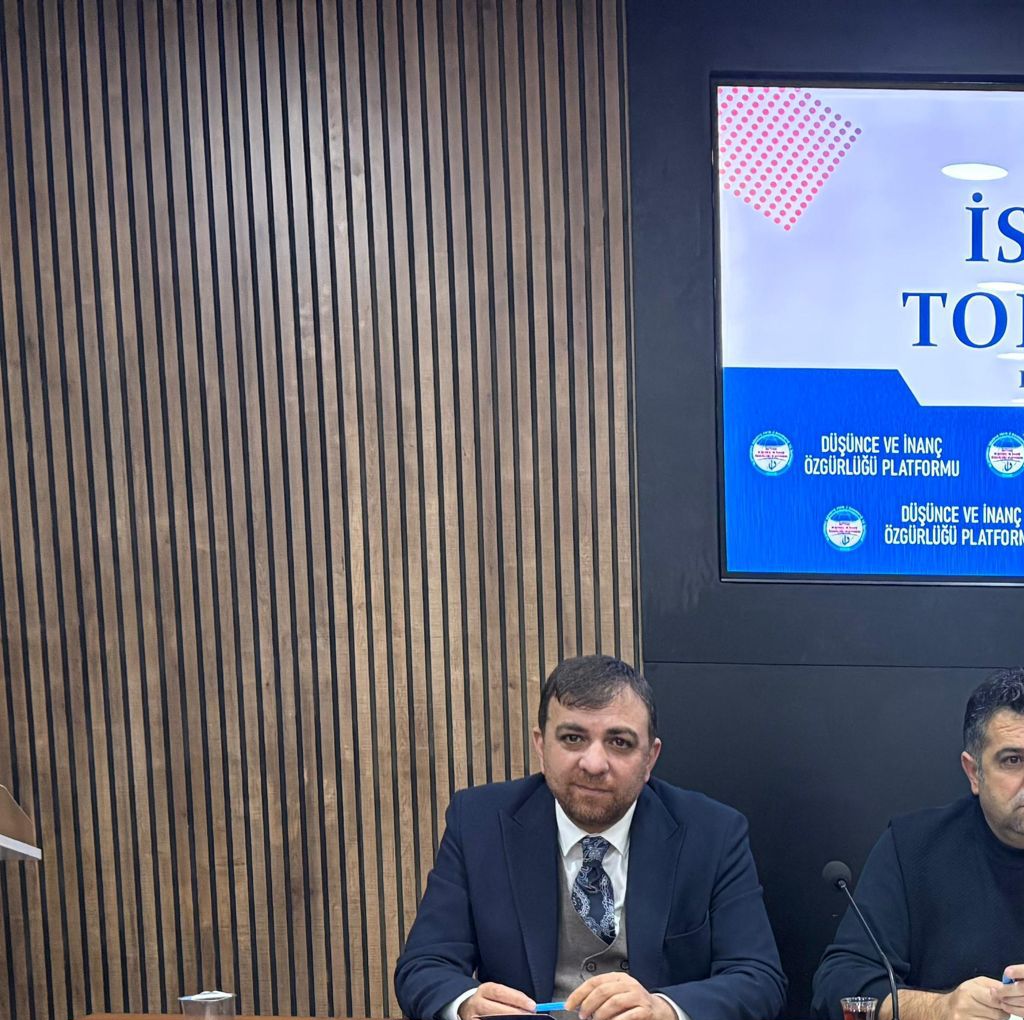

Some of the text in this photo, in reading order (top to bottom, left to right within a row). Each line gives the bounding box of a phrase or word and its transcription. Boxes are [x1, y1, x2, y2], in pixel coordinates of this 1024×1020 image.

[821, 433, 880, 458] DÜŞÜNCE
[883, 437, 900, 454] VE
[903, 434, 943, 459] İNANÇ
[804, 455, 960, 477] ÖZGÜRLÜĞÜ PLATFORMU
[901, 503, 1022, 529] DÜŞÜNCE VE İNANÇ
[884, 524, 958, 546] ÖZGÜRLÜĞÜ
